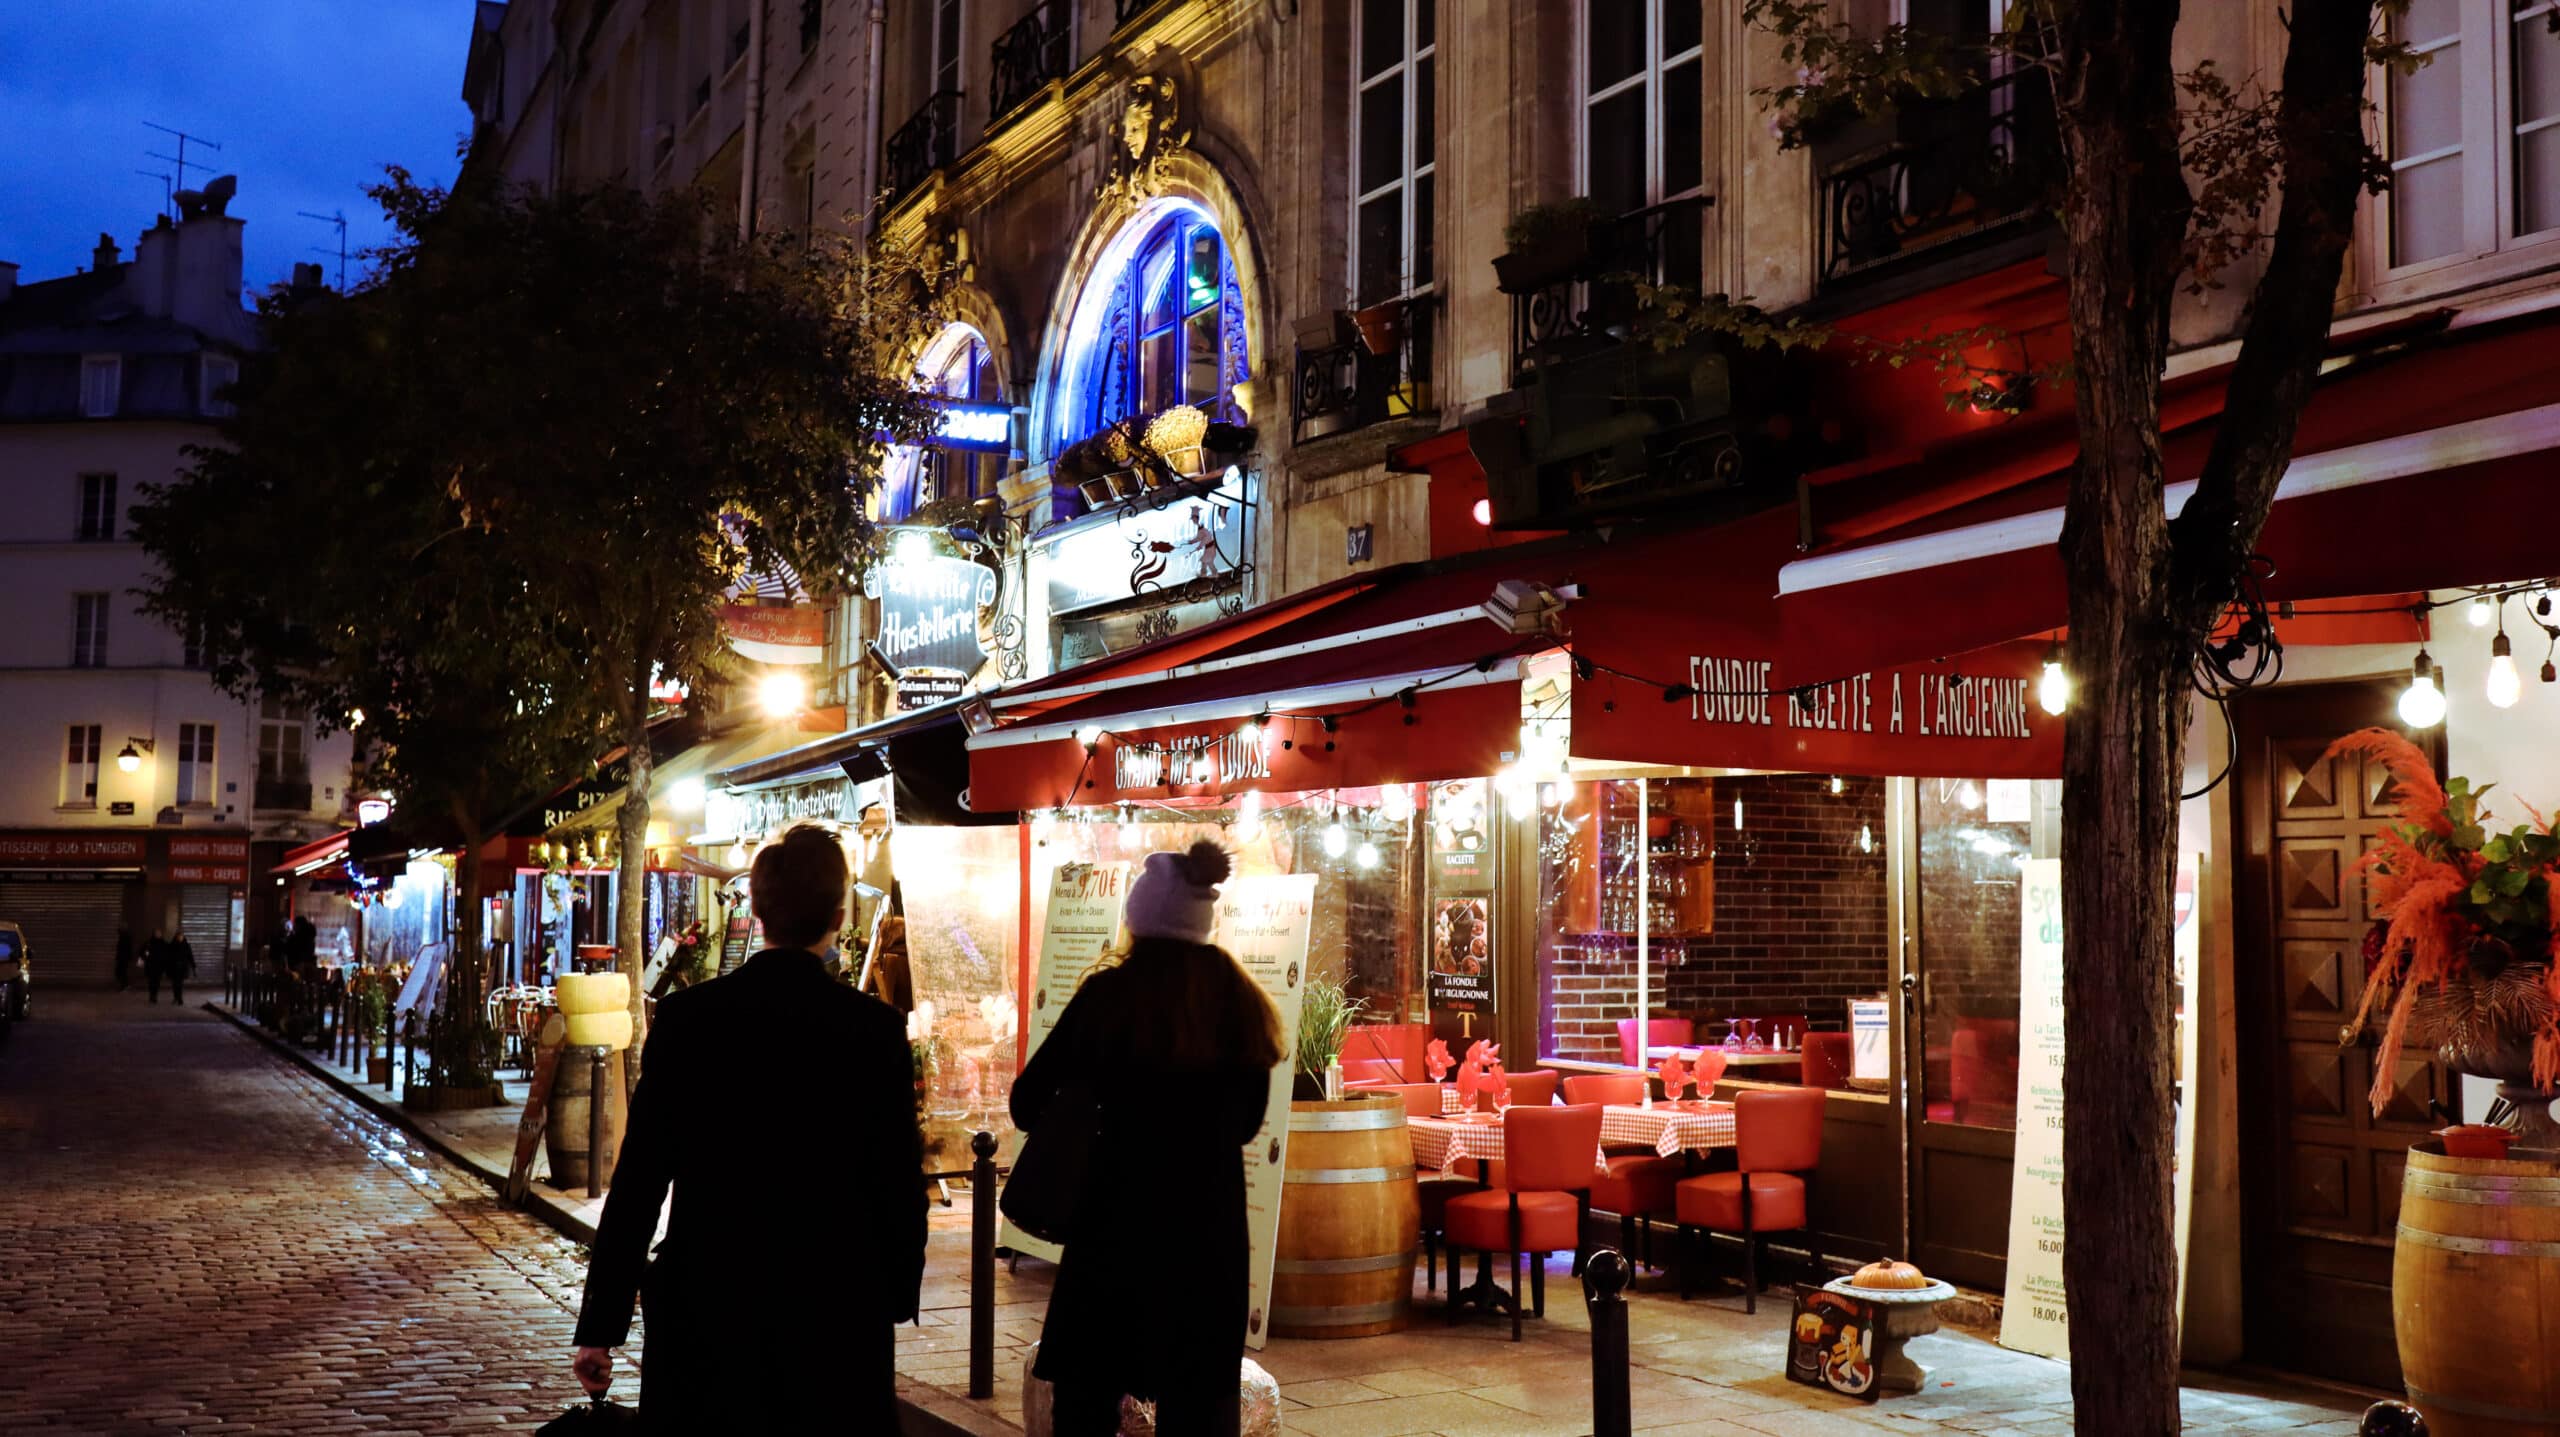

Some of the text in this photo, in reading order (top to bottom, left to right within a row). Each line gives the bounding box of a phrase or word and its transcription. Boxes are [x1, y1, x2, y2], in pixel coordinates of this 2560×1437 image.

[1349, 530, 1367, 558] 37
[884, 606, 974, 656] Hostellerie
[1690, 656, 1772, 726] FONDUE
[1889, 672, 1904, 734] A
[1919, 672, 2032, 738] L'ANCIENNE
[1218, 728, 1273, 785] LOUISE
[1434, 988, 1489, 1000] BRGUIGNONNE
